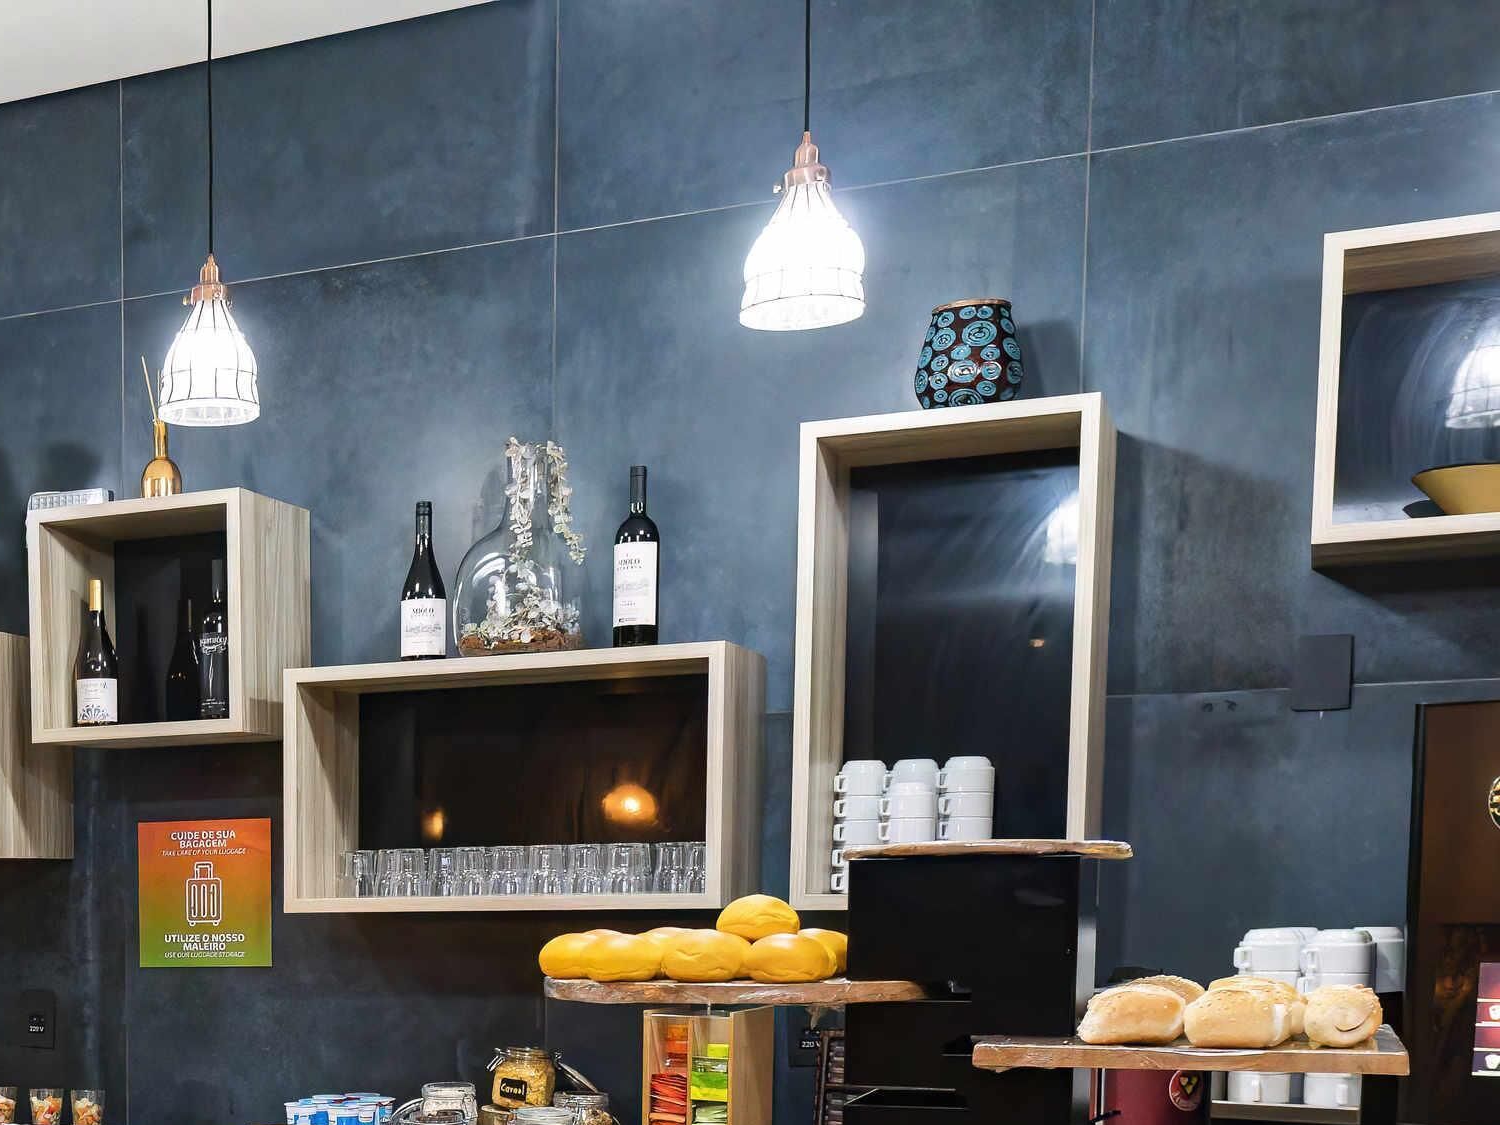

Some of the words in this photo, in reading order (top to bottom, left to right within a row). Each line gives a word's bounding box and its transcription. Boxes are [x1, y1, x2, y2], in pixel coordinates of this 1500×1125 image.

[170, 831, 200, 841] CUIDE
[201, 831, 214, 840] DE
[215, 830, 236, 839] SUA
[179, 839, 227, 849] BAGAGEM
[164, 933, 201, 943] UTILIZE
[202, 933, 210, 942] O
[211, 933, 245, 942] NOSSO
[183, 942, 226, 951] MALEIRO
